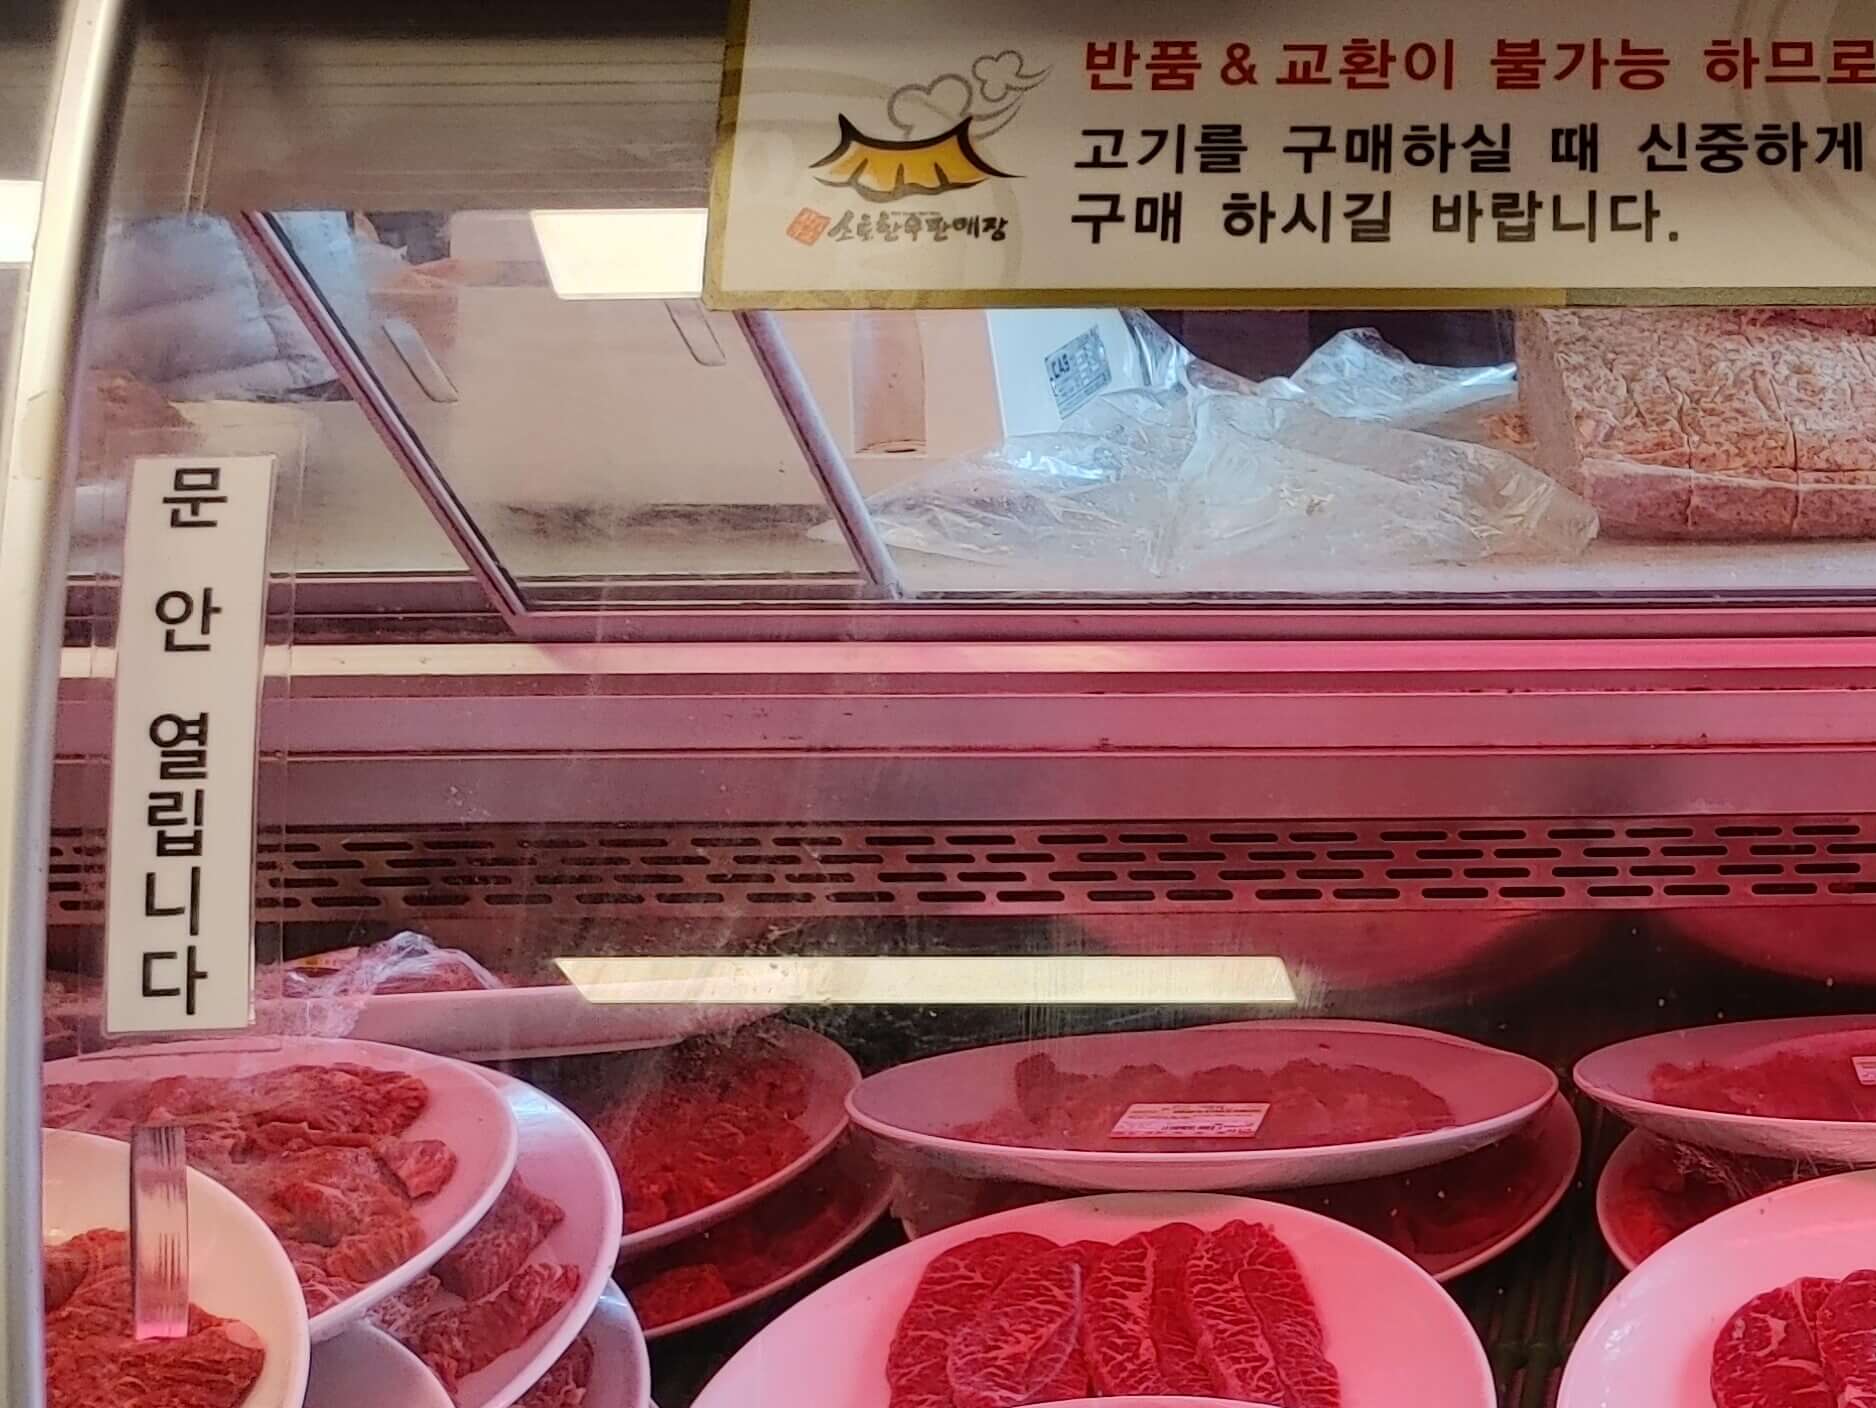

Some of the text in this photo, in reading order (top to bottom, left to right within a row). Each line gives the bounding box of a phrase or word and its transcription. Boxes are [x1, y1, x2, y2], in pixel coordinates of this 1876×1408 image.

[1086, 40, 1202, 91] 반품
[1220, 42, 1259, 85] &
[1276, 38, 1454, 90] 교환이
[1490, 38, 1670, 90] 불가능
[1074, 121, 1863, 174] 고기를 구매하실 때 신중하게
[1071, 189, 1679, 244] 구매 하시길 바랍니다.
[142, 467, 228, 1016] 문 안 열립니다
